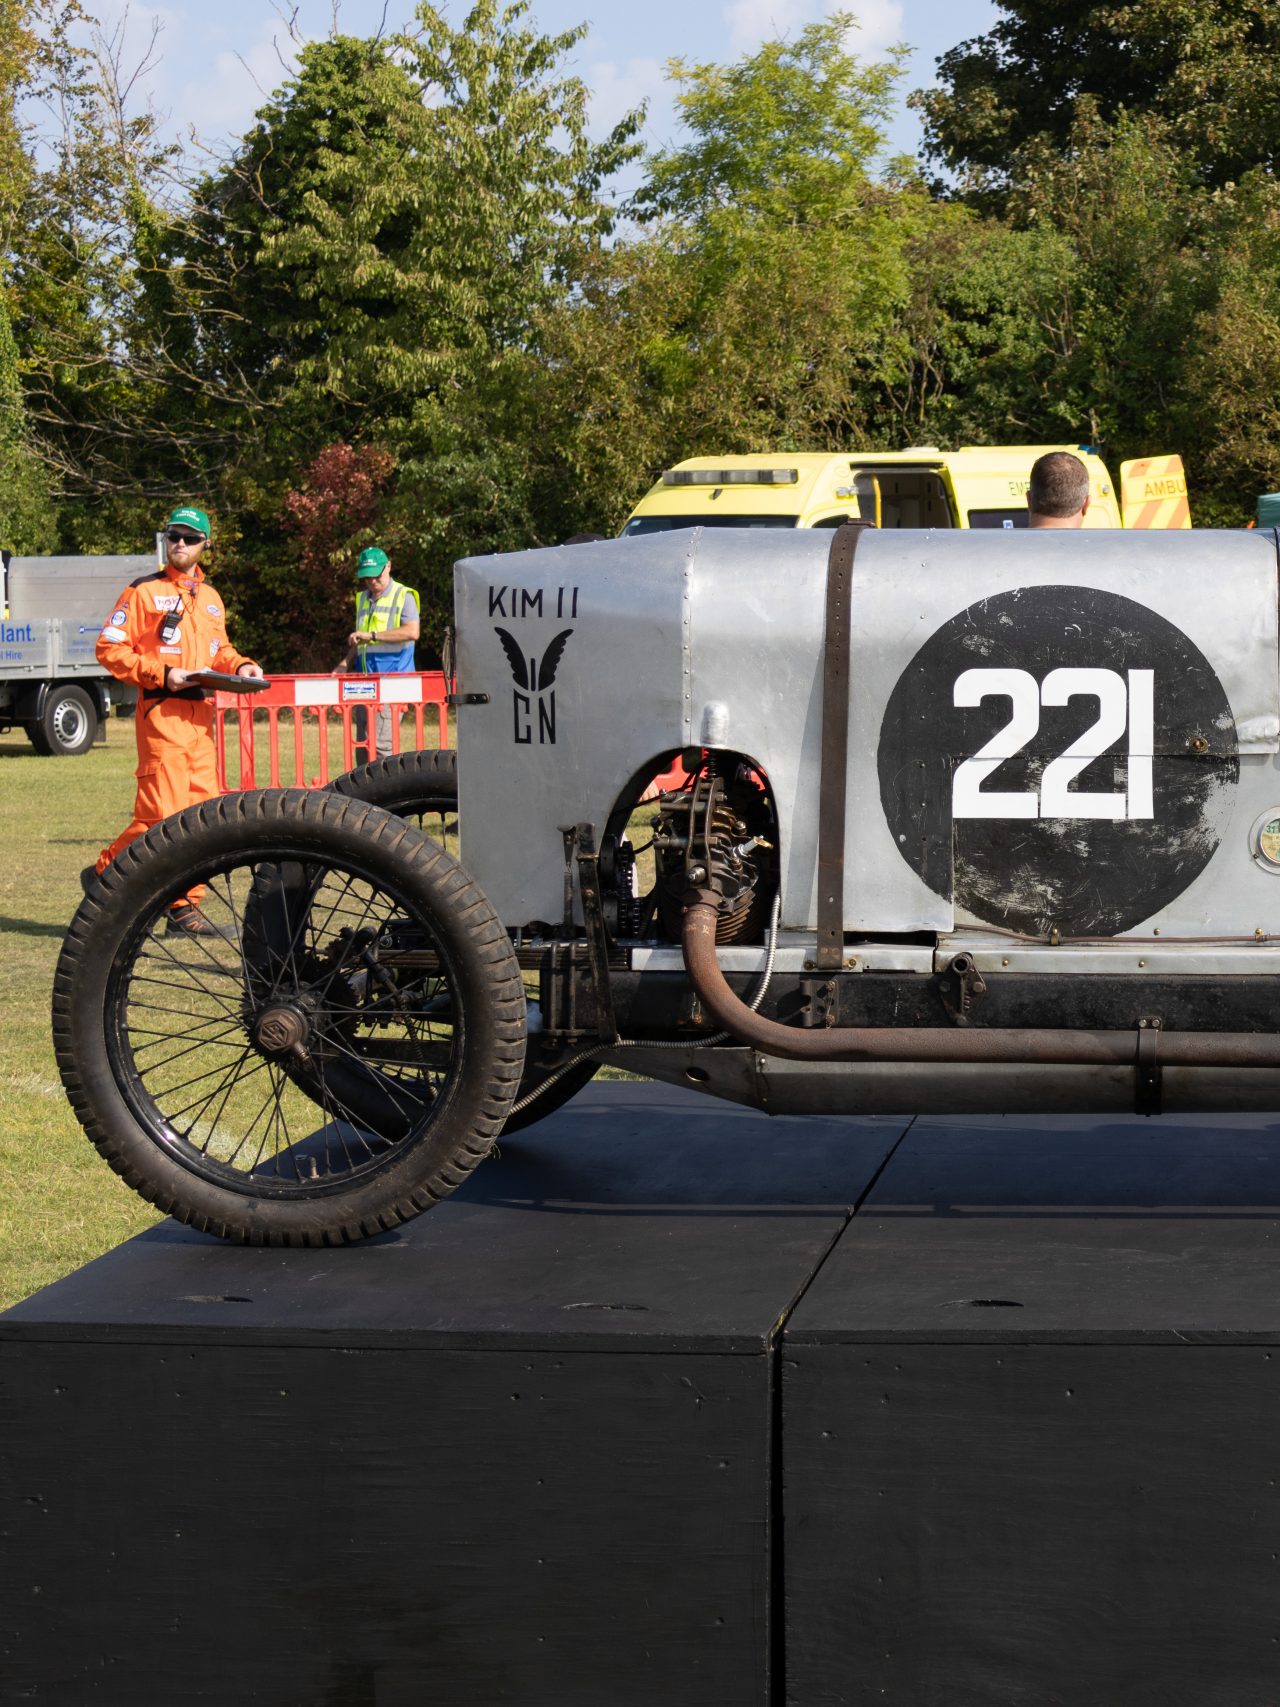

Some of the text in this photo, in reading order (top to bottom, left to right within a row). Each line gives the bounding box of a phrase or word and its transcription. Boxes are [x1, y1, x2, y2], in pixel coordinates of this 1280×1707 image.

[1144, 478, 1186, 496] AMBU
[488, 585, 579, 618] KIM II
[952, 667, 1155, 820] 221
